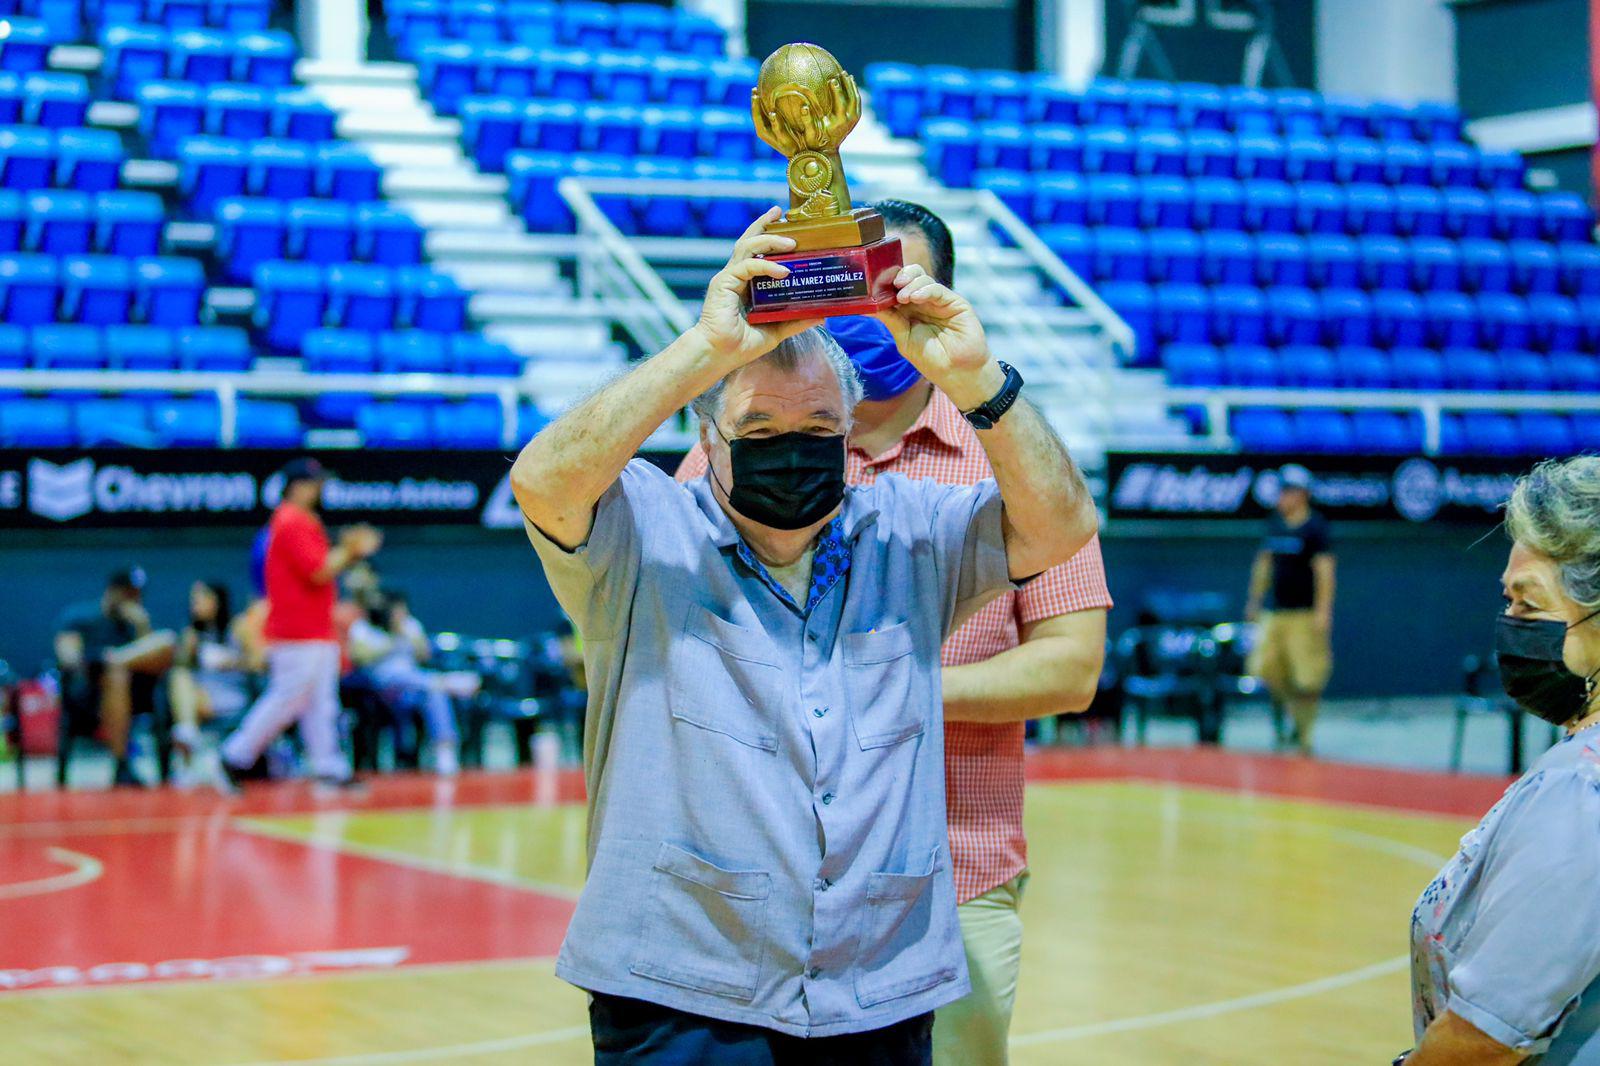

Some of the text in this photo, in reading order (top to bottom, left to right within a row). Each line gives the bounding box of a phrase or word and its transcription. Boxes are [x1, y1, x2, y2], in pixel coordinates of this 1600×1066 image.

[756, 271, 864, 290] CESÁREO ÁLVAREZ GONZÁLEZ
[96, 465, 256, 512] Chevron
